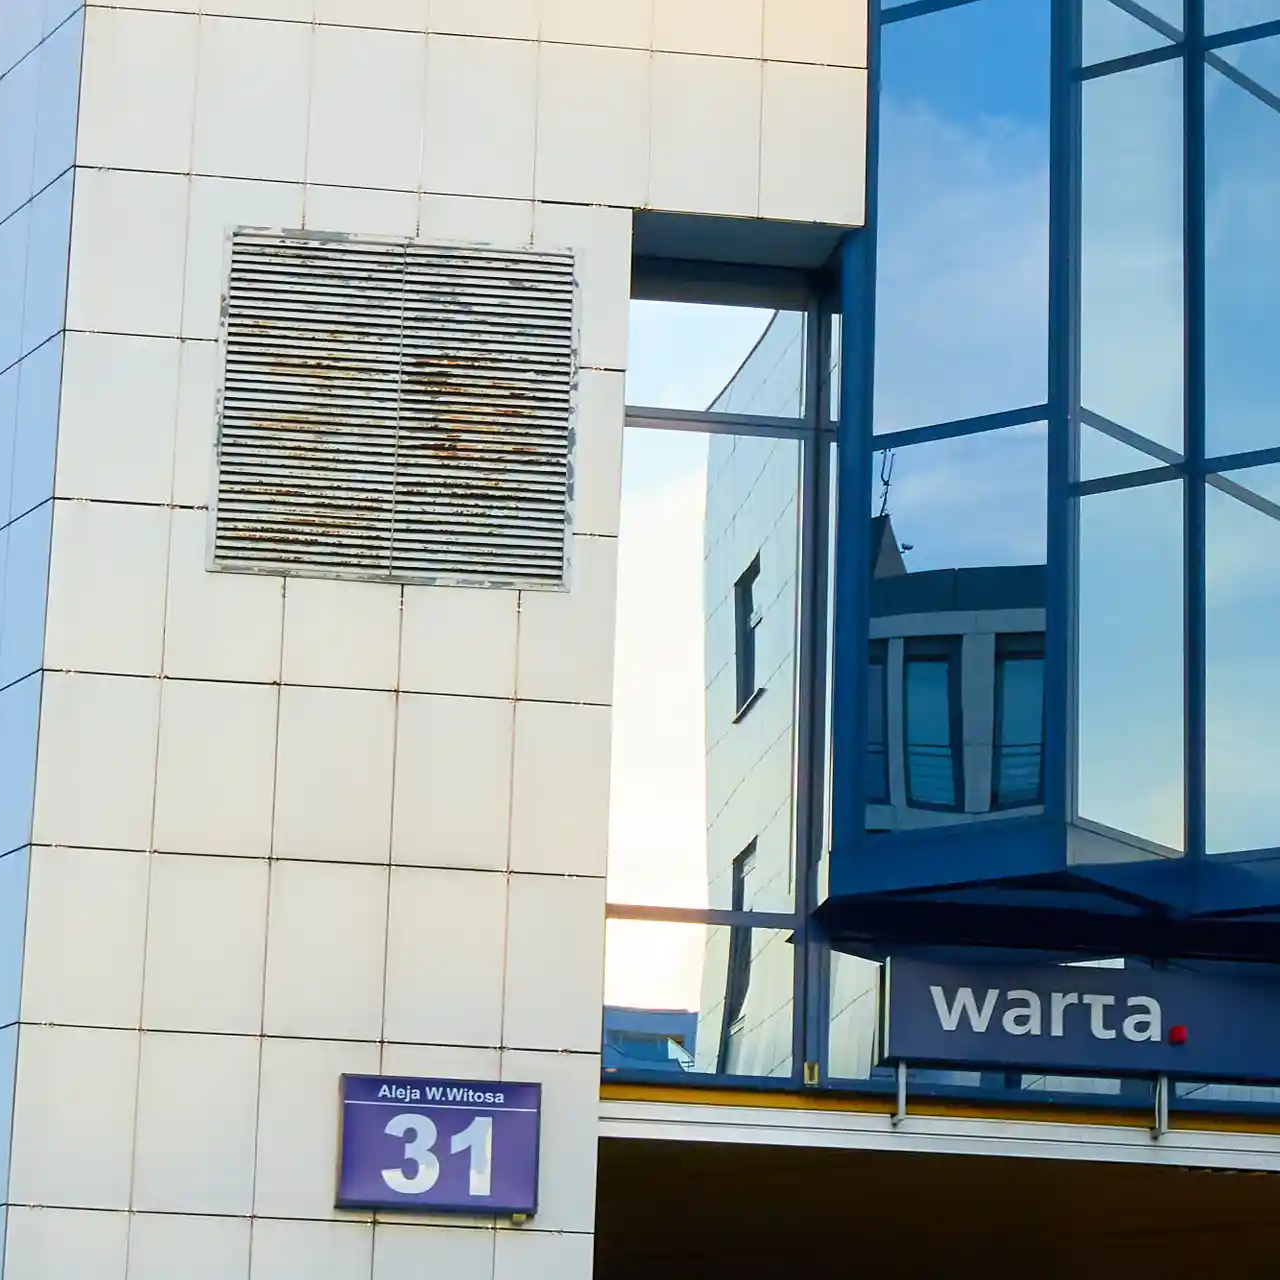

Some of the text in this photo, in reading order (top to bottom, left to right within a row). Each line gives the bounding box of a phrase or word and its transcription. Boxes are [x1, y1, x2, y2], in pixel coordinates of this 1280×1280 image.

[378, 1084, 505, 1104] Aleja W.Witosa
[381, 1113, 493, 1196] 31
